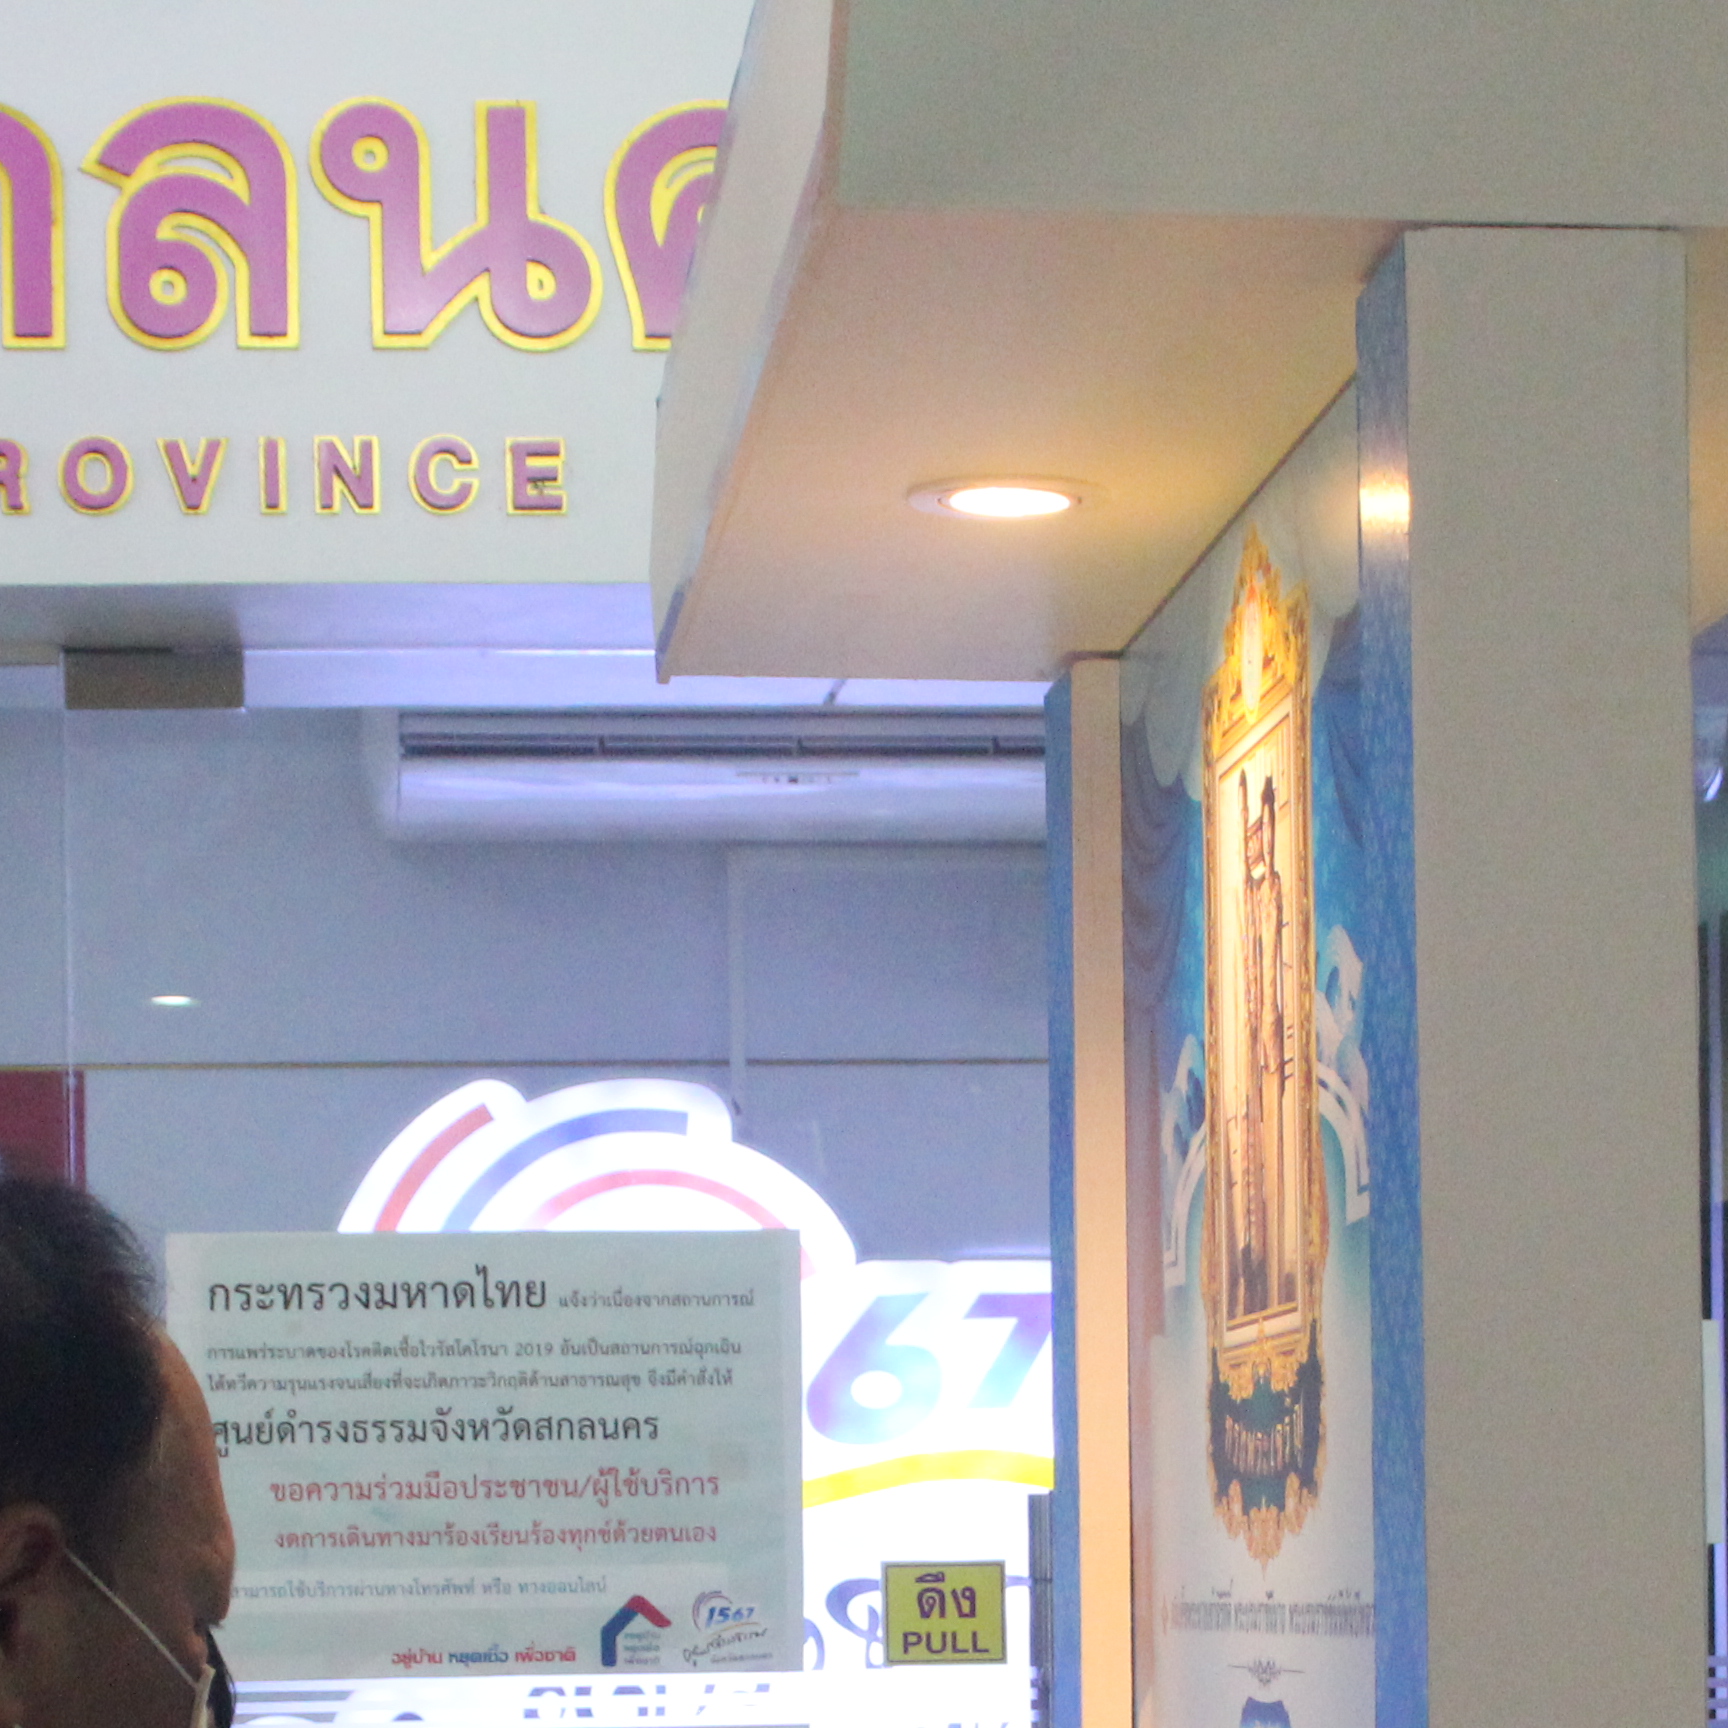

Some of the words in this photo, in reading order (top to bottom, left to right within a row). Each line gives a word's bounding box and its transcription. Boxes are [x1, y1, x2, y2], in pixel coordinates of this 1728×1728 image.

[208, 1263, 547, 1312] กระทรวงมหาดไทย
[515, 1342, 554, 1357] 2019
[210, 1405, 660, 1459] ศูนย์ดำรงธรรมจังหวัดสกลนคร
[269, 1466, 720, 1508] ขอความร่วมมือประชาชน/ผู้ใช้บริการ
[915, 1571, 978, 1620] ดึง
[705, 1606, 756, 1628] 1567
[901, 1630, 991, 1657] PULL
